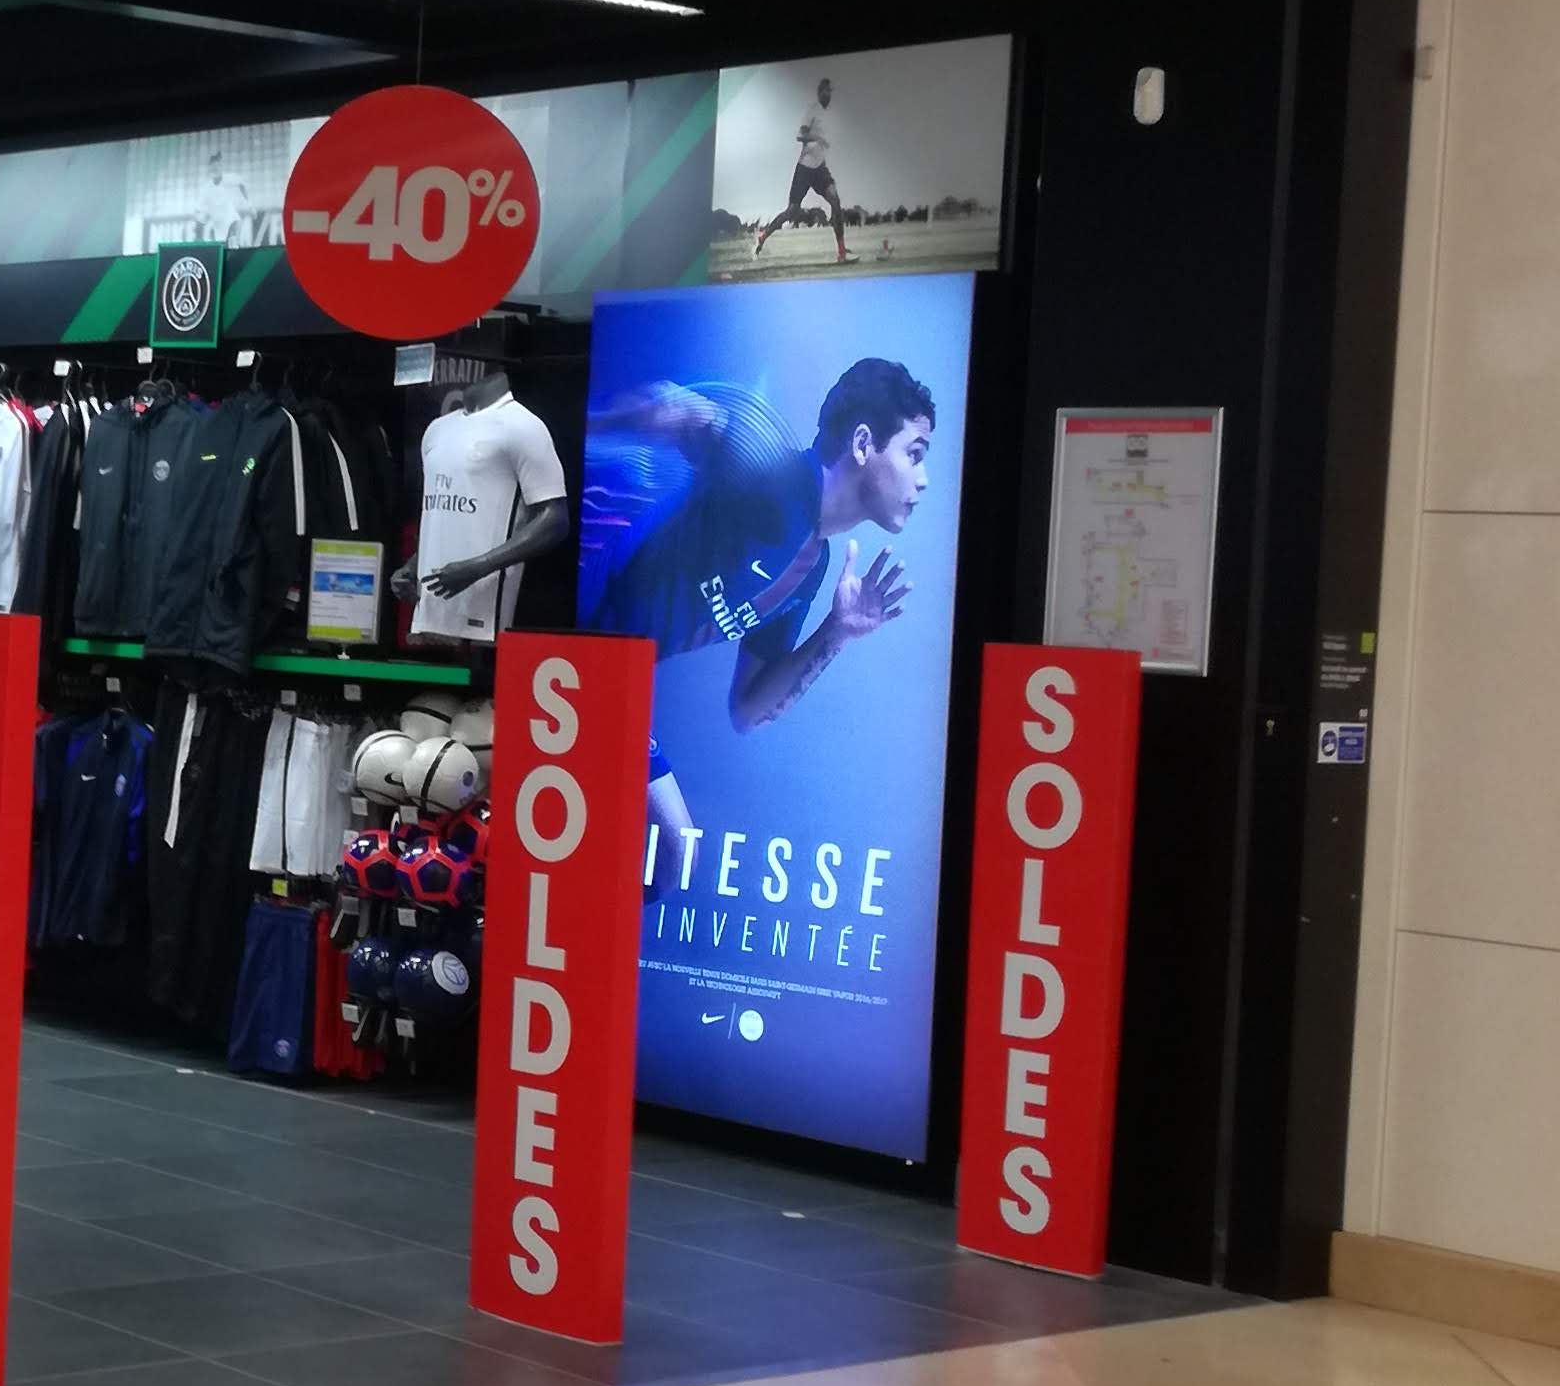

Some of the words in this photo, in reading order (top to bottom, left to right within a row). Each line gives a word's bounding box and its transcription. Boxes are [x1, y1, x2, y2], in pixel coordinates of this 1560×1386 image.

[292, 165, 526, 264] -40%
[172, 260, 204, 280] PARIS
[434, 357, 486, 385] ERRATTI
[425, 491, 478, 514] mirates
[700, 574, 746, 642] Emira
[736, 601, 761, 629] Fly
[643, 824, 892, 917] ITESSE
[656, 903, 887, 972] INVENTÉE
[998, 665, 1083, 1234] SOLDES
[509, 657, 587, 1296] SOLDES
